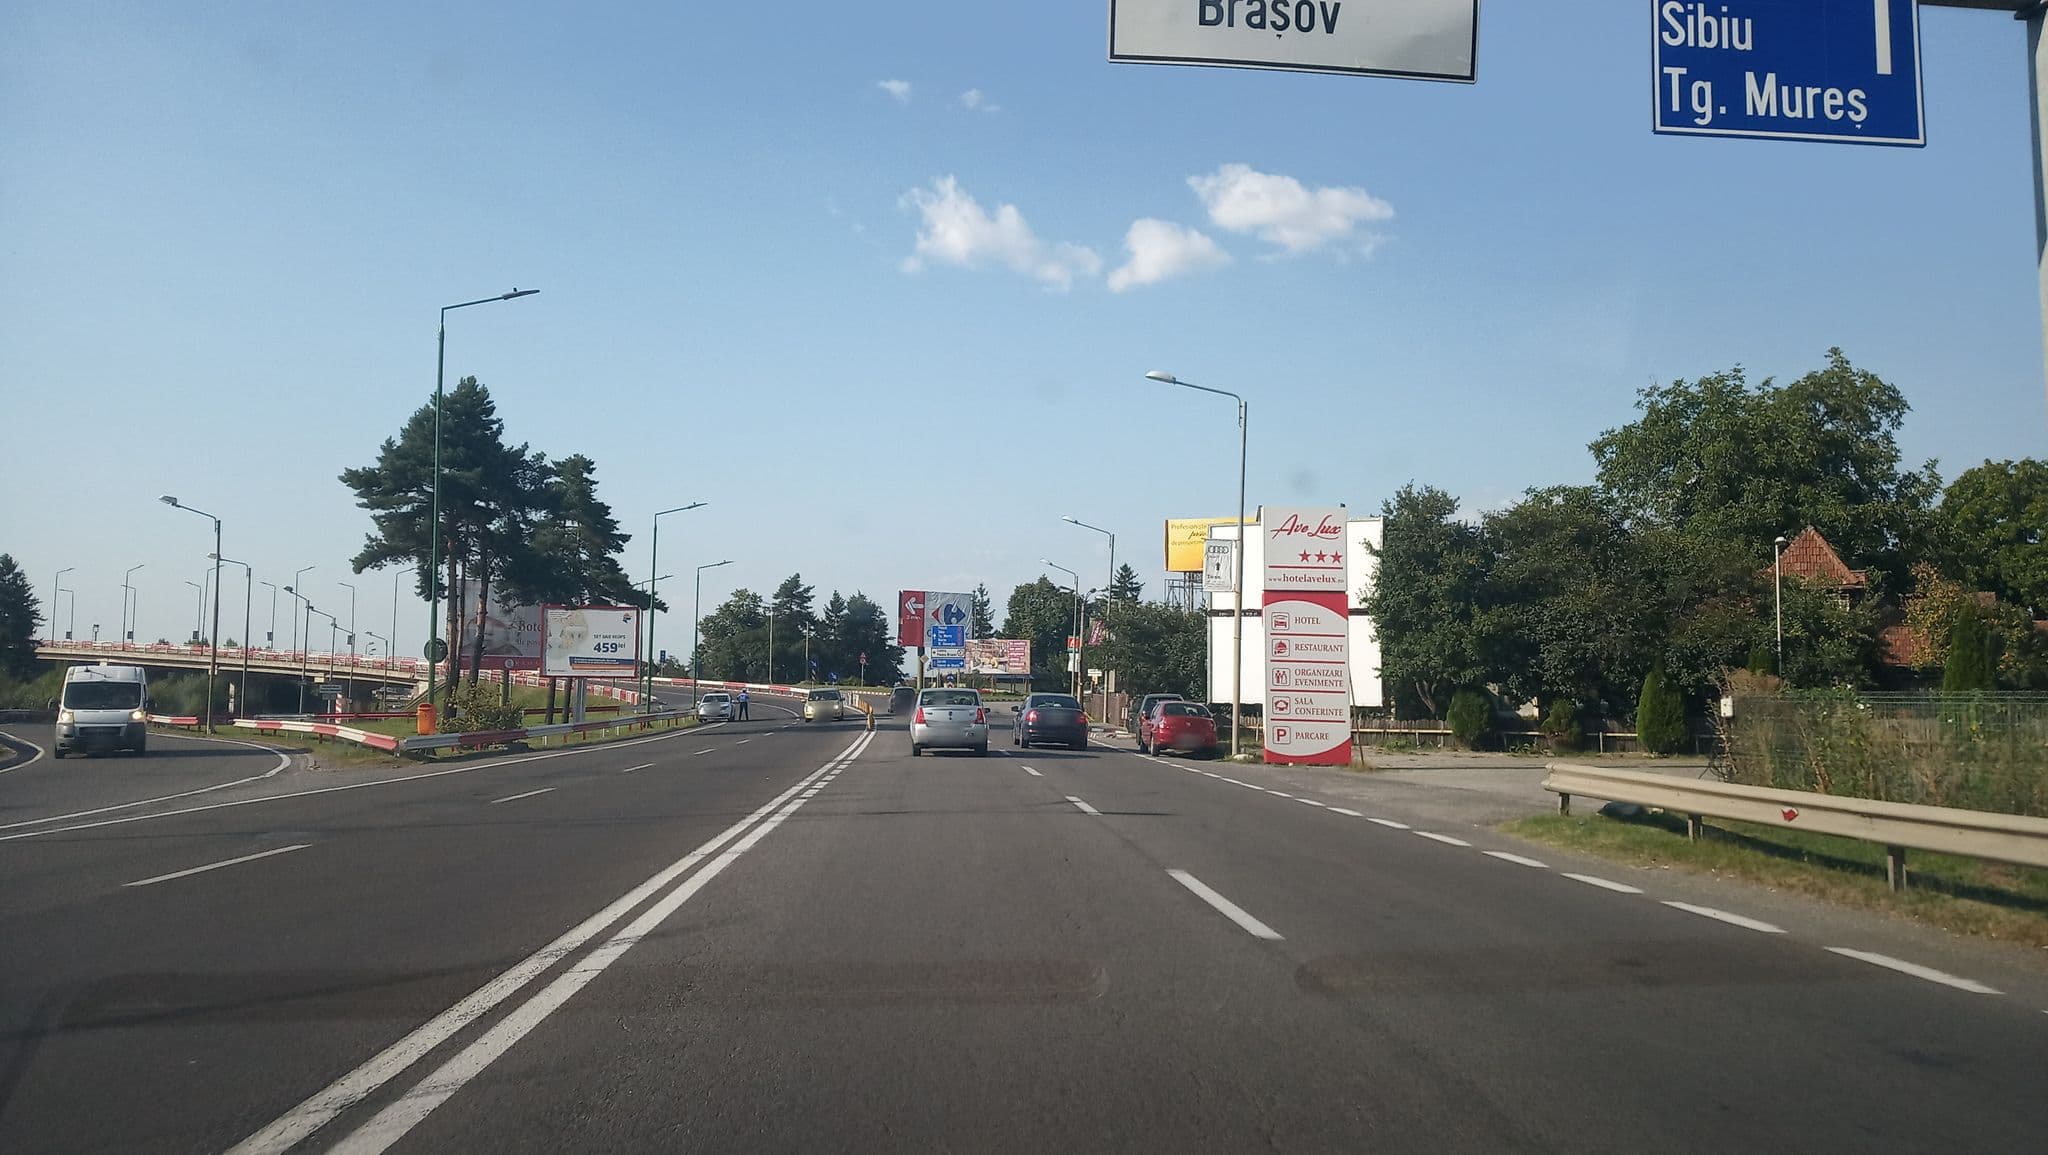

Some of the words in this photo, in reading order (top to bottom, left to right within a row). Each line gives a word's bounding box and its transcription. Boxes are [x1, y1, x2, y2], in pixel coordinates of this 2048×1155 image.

[1662, 1, 1753, 50] Sibiu
[1663, 66, 1727, 125] Tg.
[1744, 71, 1868, 129] Mureș
[1294, 616, 1321, 625] HOTEL
[593, 642, 618, 653] 459
[1294, 643, 1344, 653] RESTAURANT
[1294, 668, 1343, 678] ORGANIZARI
[1294, 678, 1344, 688] EVENIMENTE
[1294, 697, 1314, 705] SALA
[1294, 707, 1344, 717] CONFERINTE
[1295, 732, 1329, 741] PARCARE
